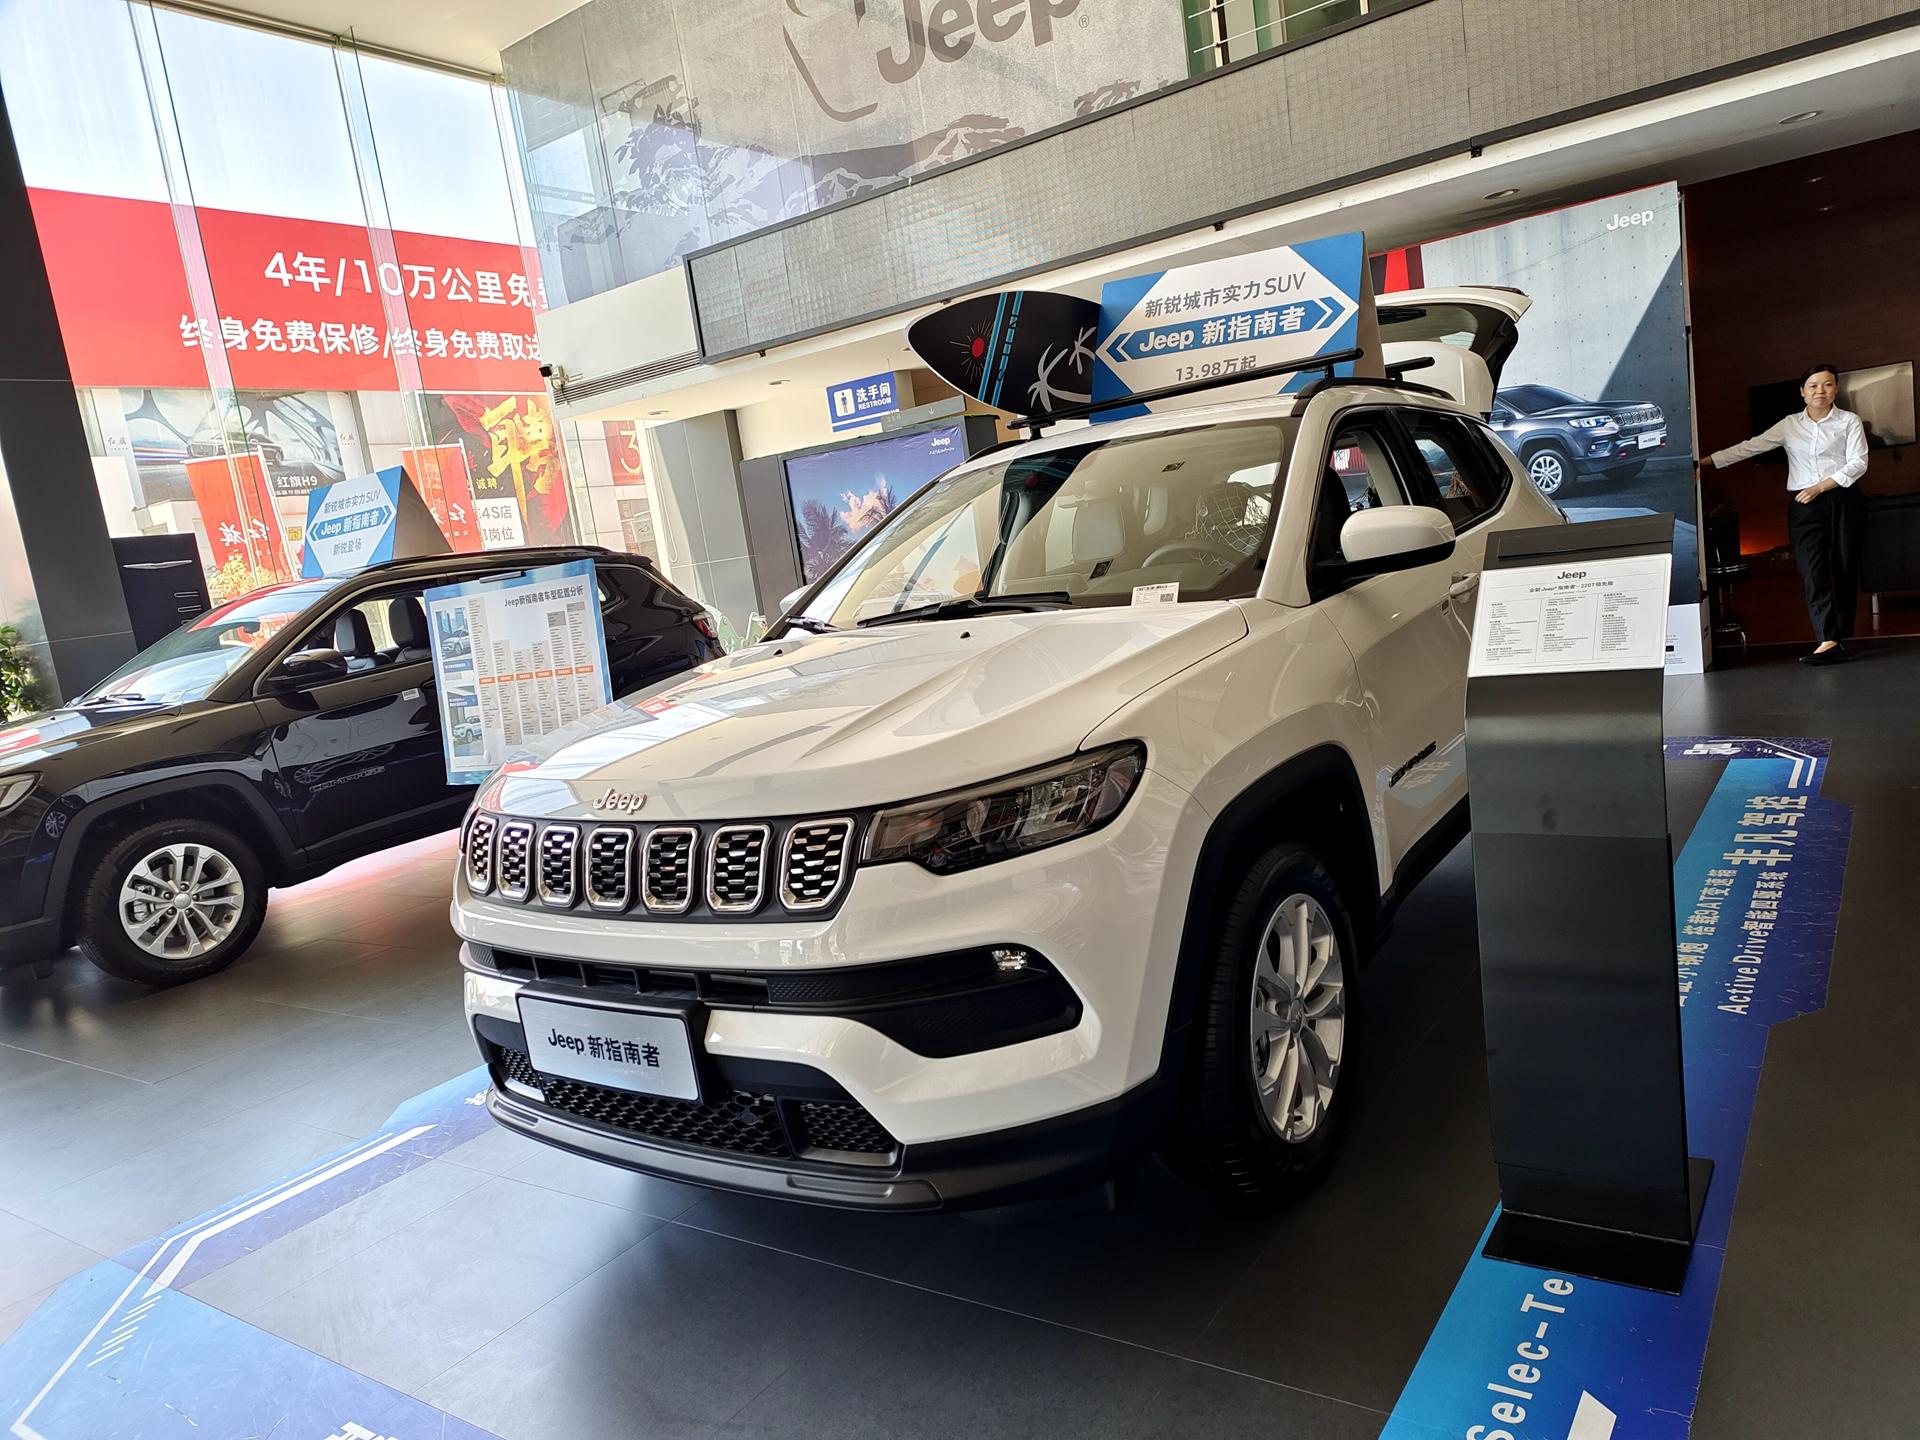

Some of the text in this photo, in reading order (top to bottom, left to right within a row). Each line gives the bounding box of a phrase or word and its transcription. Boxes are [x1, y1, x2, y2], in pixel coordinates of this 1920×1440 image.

[1606, 210, 1654, 230] Jeep
[1145, 272, 1307, 318] 新锐城市实力SUV
[1139, 306, 1306, 353] Jeep 新指南者
[1175, 356, 1257, 382] 13.98万起
[856, 382, 892, 403] 洗手间
[858, 396, 892, 411] RESTROOM
[931, 437, 951, 447] Jeep
[277, 475, 318, 488] 红旗H9
[320, 522, 342, 536] Jeep
[343, 510, 379, 532] 新指南者
[1557, 571, 1587, 580] Jeep
[593, 788, 648, 815] Jeep
[1722, 796, 1808, 867] 非凡驾控
[548, 1028, 660, 1068] Jeep 新指南者
